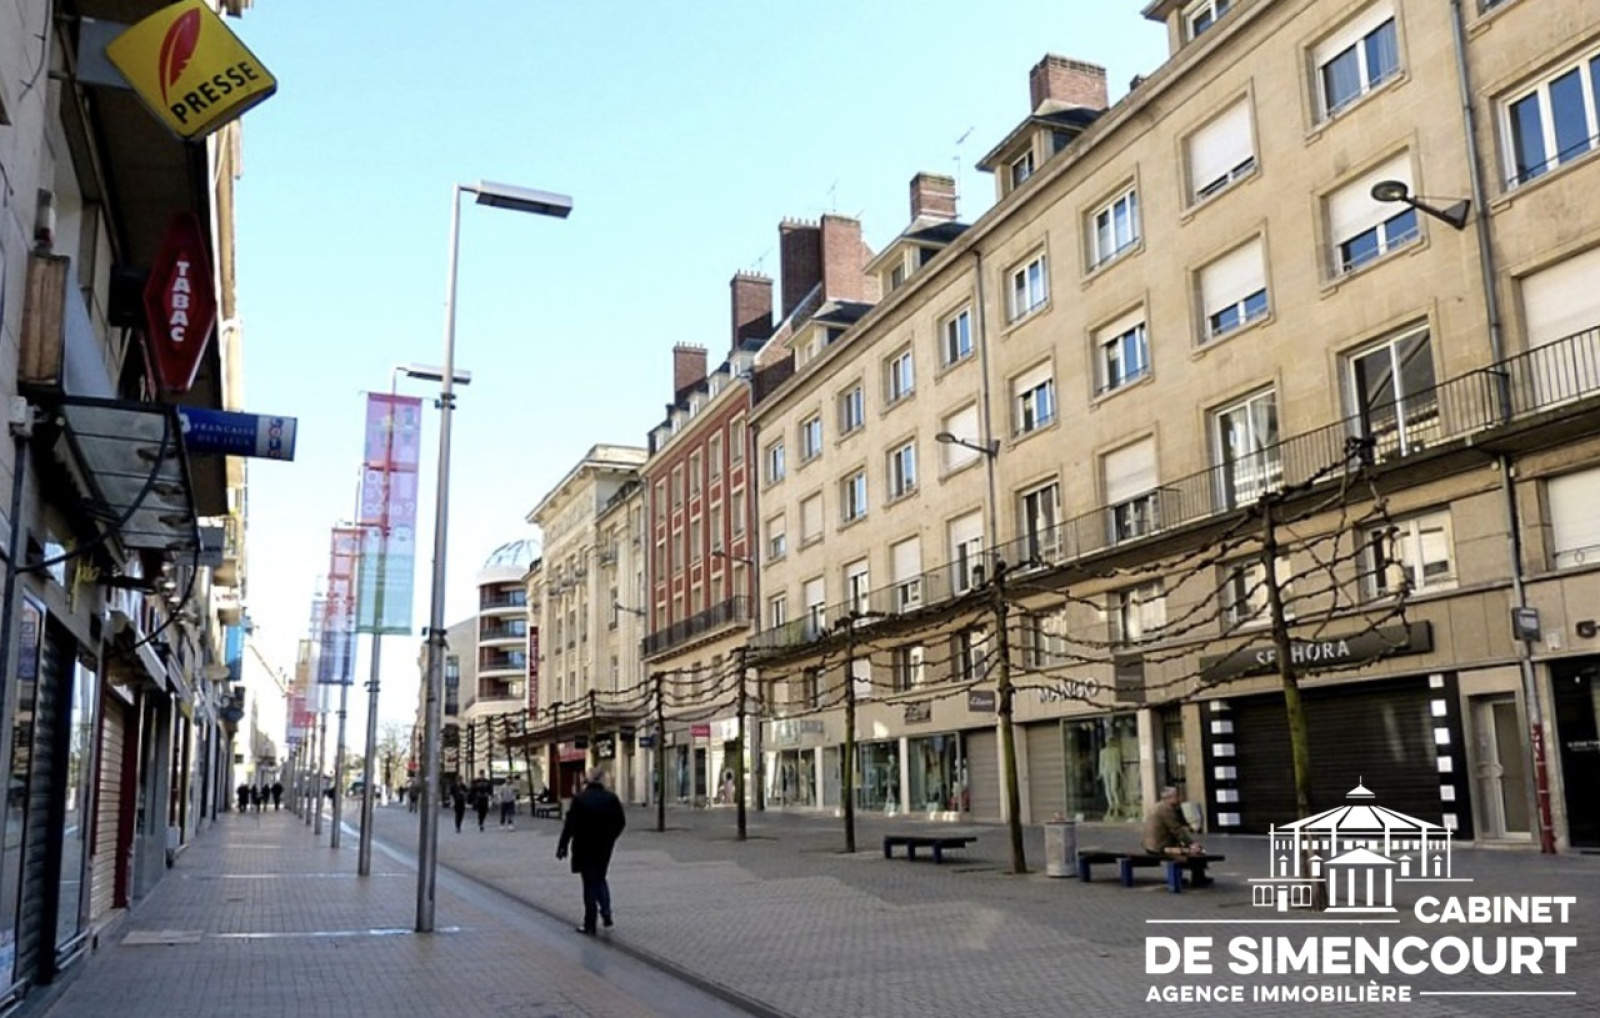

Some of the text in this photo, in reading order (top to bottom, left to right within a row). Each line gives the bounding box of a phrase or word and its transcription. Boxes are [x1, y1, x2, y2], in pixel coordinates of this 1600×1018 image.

[170, 61, 260, 125] PRESSE
[169, 261, 191, 342] TABAC
[1256, 640, 1350, 665] SEHORA
